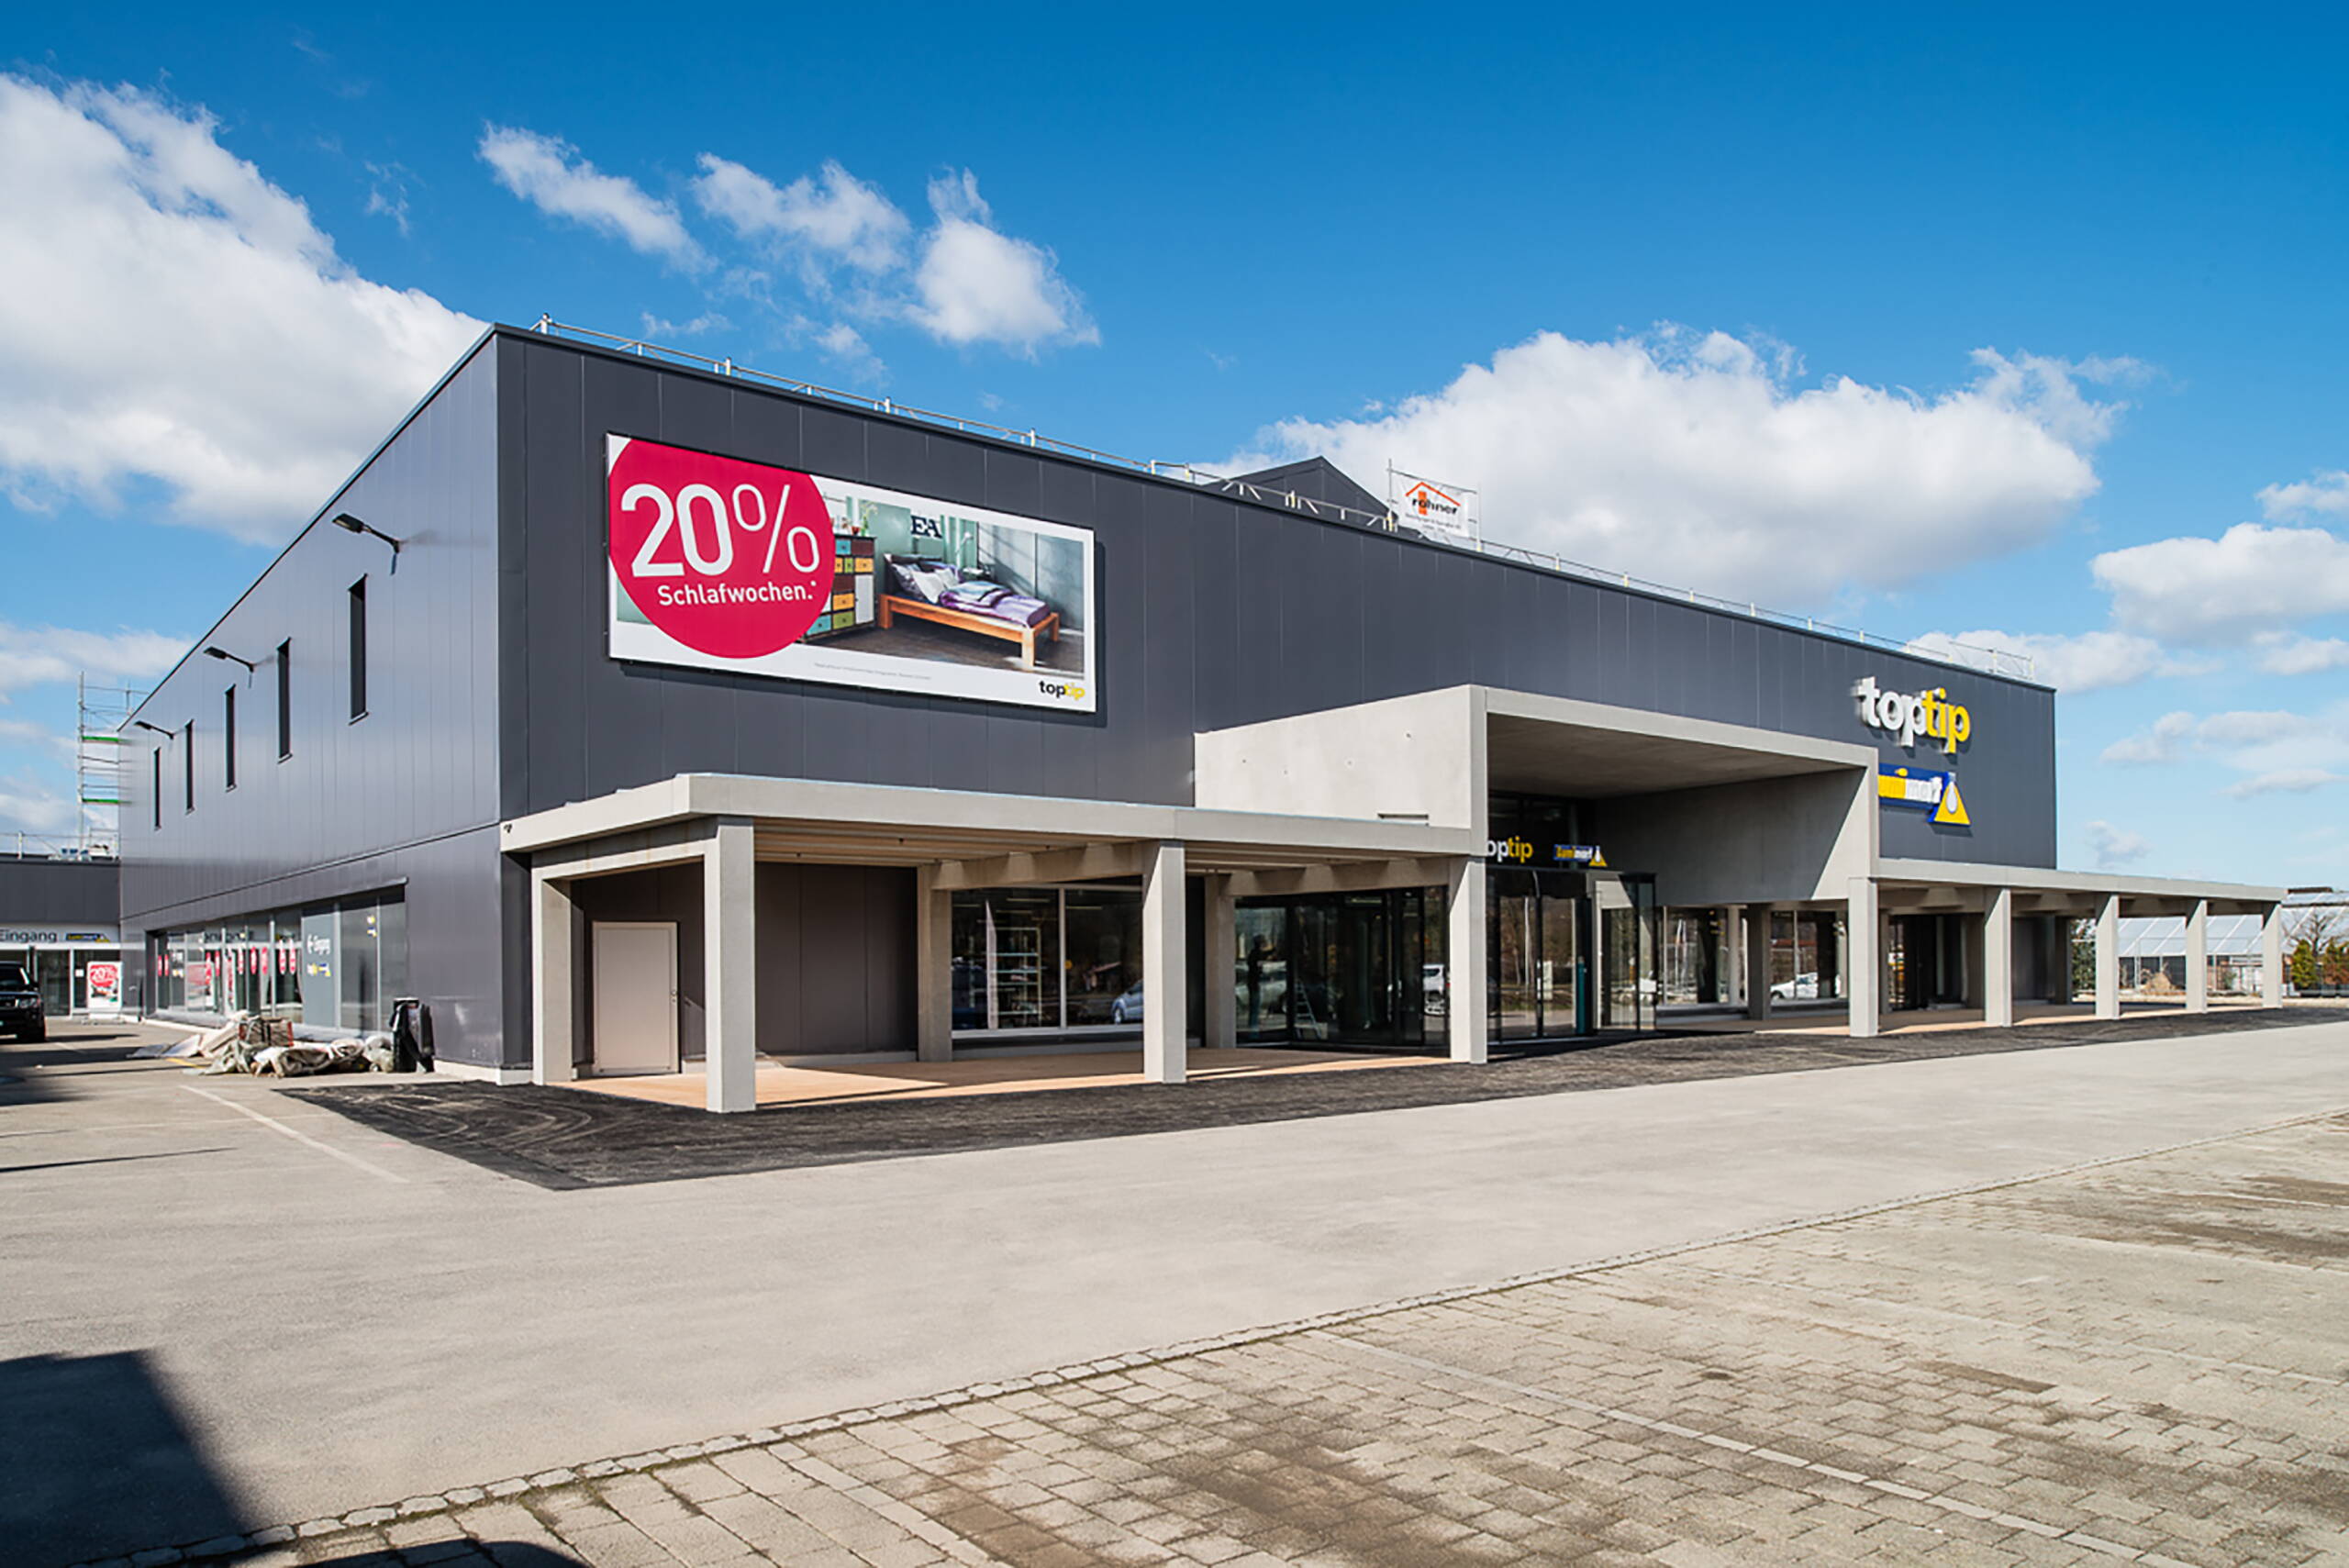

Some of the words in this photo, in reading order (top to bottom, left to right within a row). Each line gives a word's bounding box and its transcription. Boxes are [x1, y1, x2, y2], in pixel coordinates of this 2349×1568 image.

[620, 483, 820, 578] 20%
[910, 515, 942, 539] EA
[1039, 679, 1085, 700] toptip
[1852, 675, 1971, 753] toptip
[1486, 835, 1534, 863] optip
